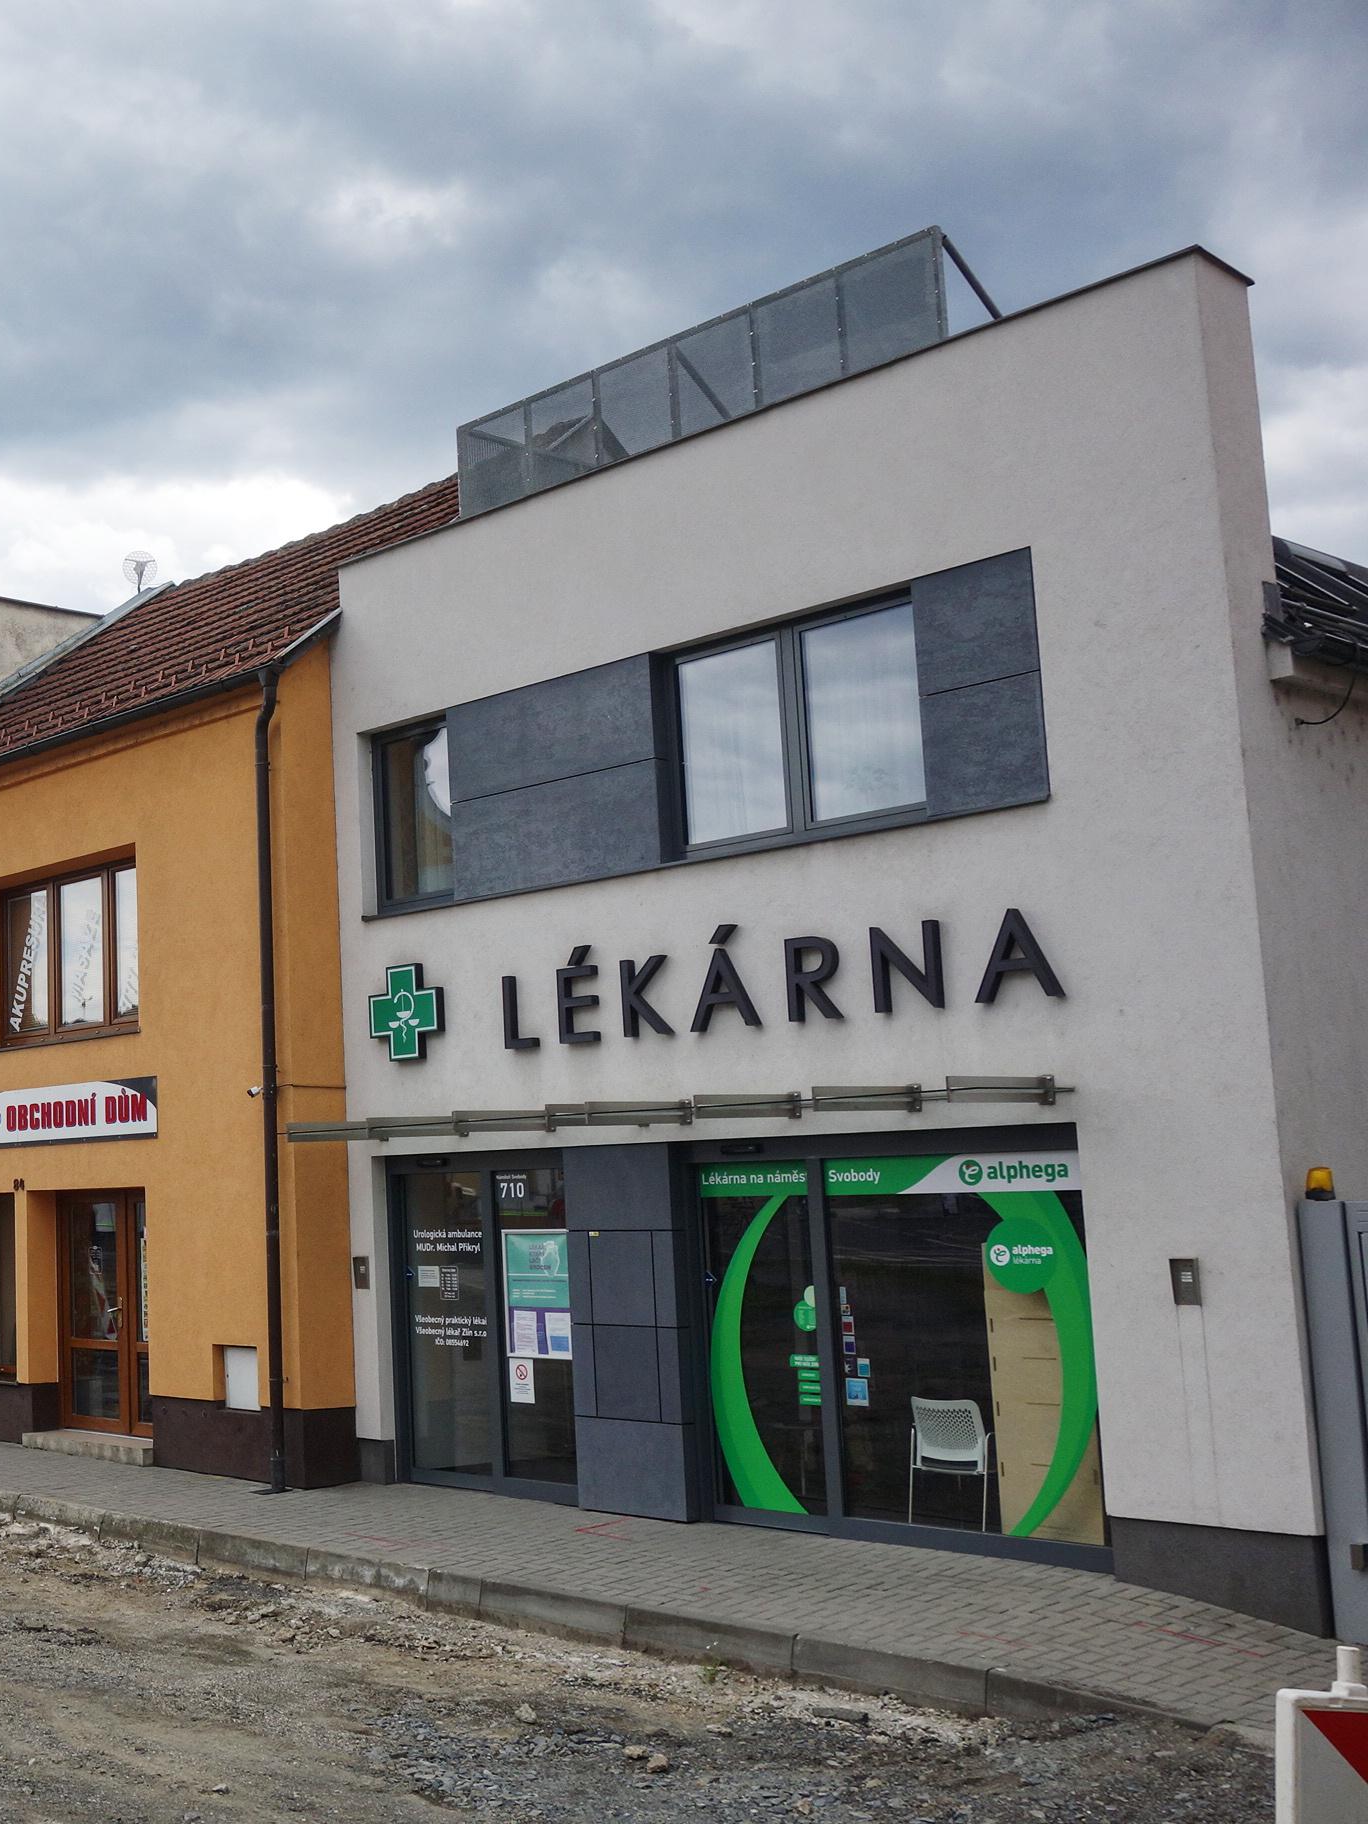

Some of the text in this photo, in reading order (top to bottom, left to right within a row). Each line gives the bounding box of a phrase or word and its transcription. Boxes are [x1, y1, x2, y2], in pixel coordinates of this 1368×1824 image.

[501, 908, 1066, 1050] LÉKÁRNA
[6, 1092, 97, 1132] OBCHODNÍ
[105, 1087, 147, 1124] DŮM
[701, 1168, 881, 1185] Lékárna na náměs Svobody
[986, 1160, 1069, 1184] alphega
[13, 1178, 25, 1191] 84
[500, 1182, 525, 1199] 710
[413, 1228, 482, 1240] Urologická ambulance
[416, 1242, 435, 1252] MUDr.
[436, 1242, 457, 1252] Michal
[1012, 1244, 1054, 1256] alphega
[414, 1314, 445, 1325] Všeobecný
[445, 1315, 472, 1326] praktický
[415, 1326, 445, 1337] Všeobecný
